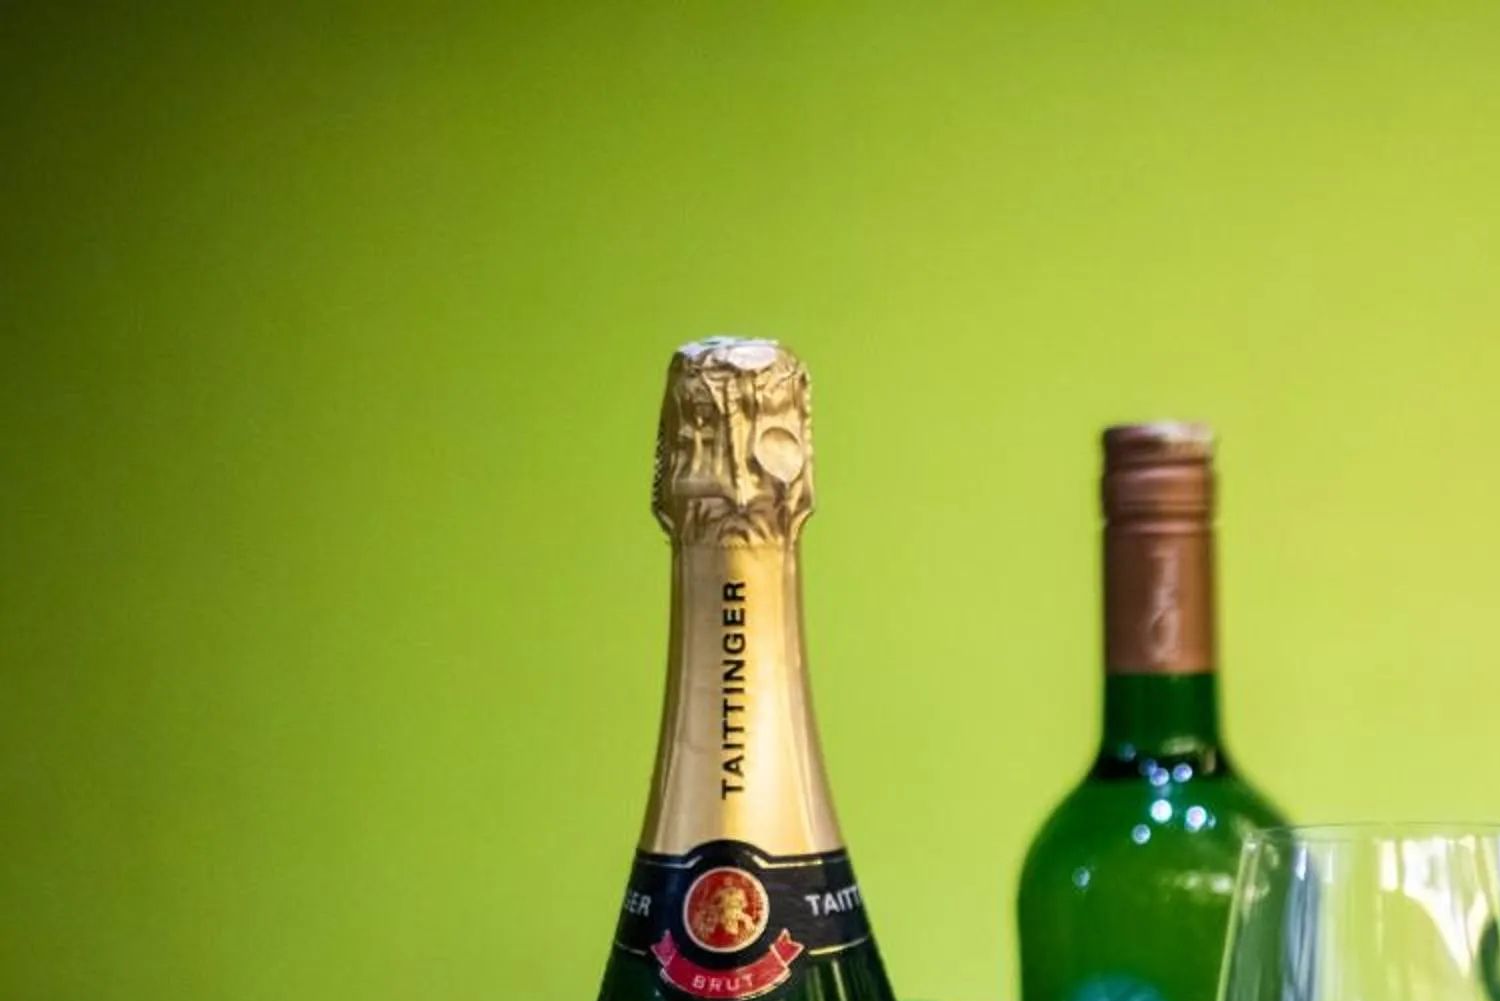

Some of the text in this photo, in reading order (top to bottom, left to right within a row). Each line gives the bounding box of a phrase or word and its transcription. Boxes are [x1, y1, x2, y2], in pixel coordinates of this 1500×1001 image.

[721, 580, 746, 800] TAITTINGER
[624, 891, 652, 918] ER
[691, 972, 753, 992] BRUT
